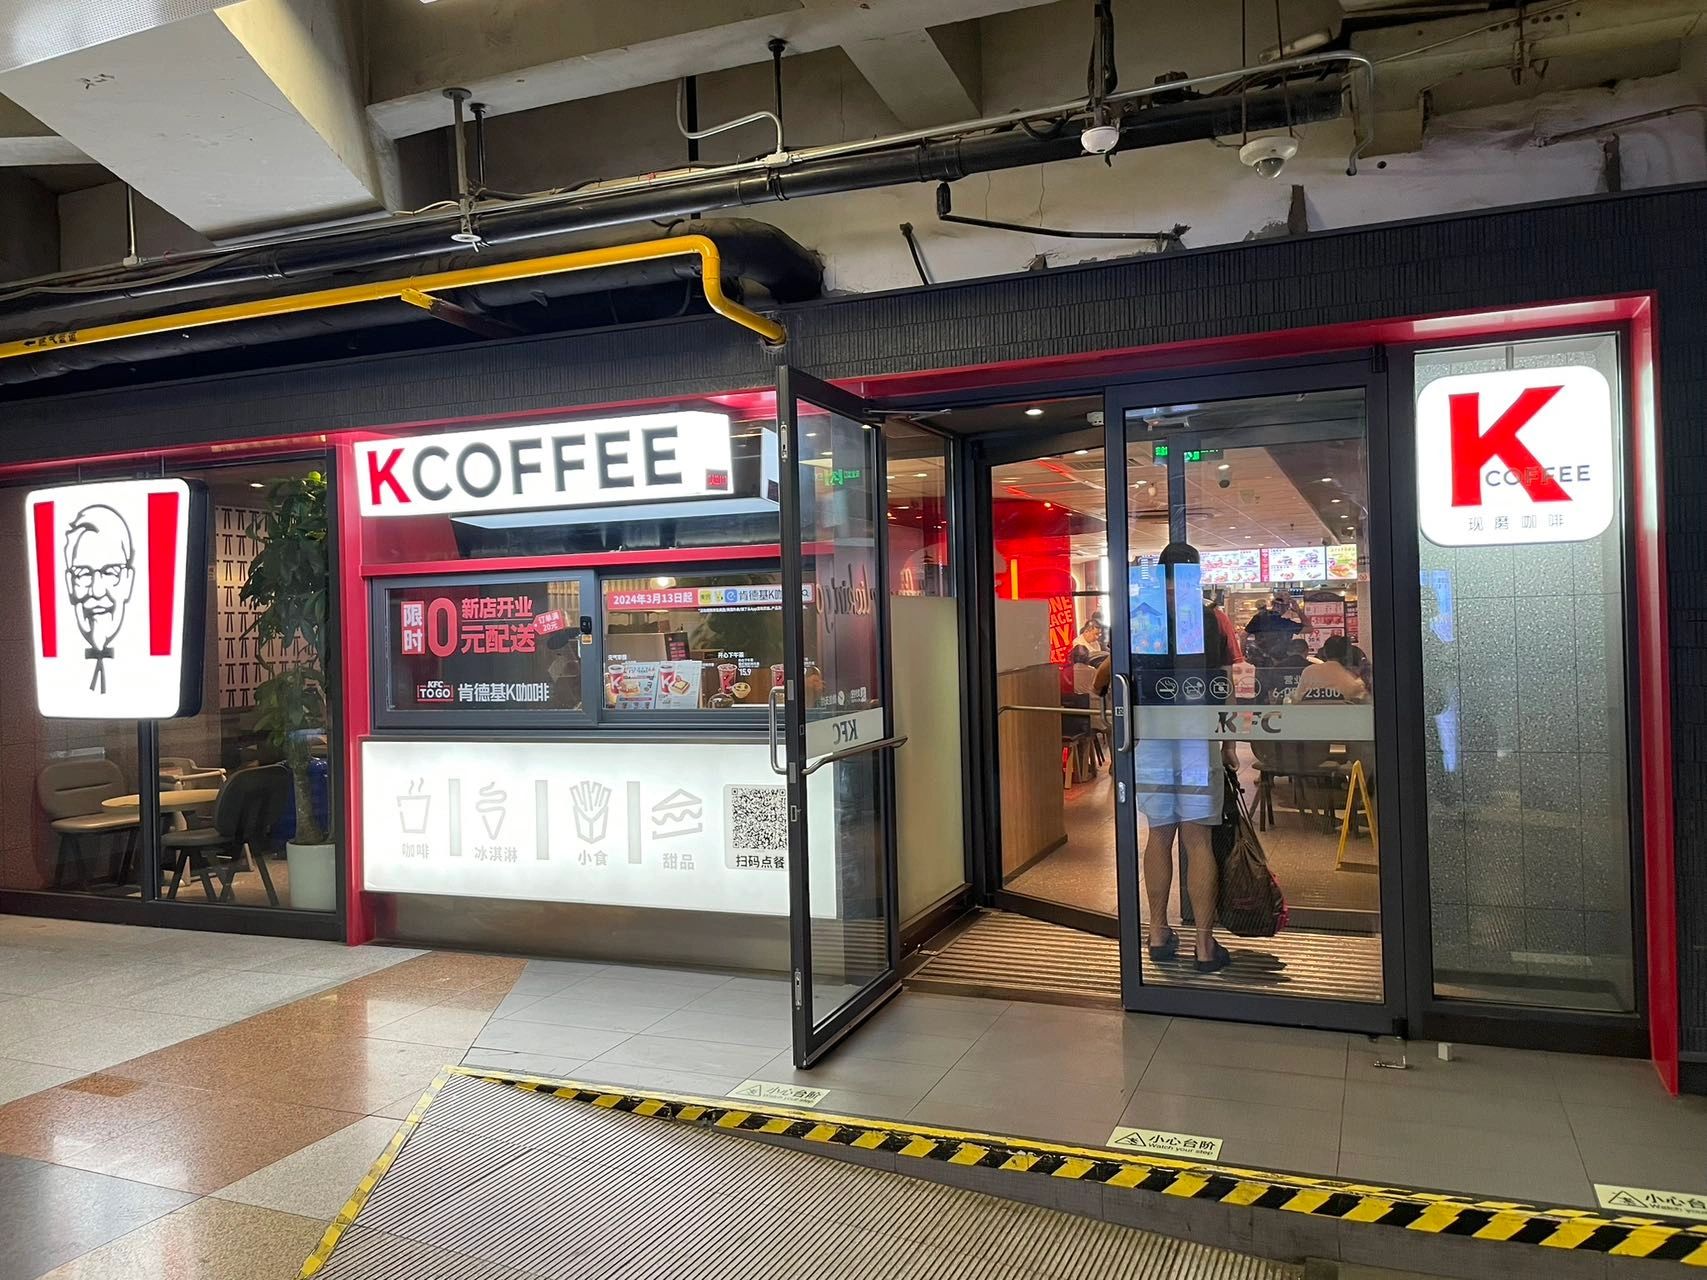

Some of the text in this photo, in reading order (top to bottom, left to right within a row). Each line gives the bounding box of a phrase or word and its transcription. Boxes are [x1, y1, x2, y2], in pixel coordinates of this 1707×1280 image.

[1448, 385, 1574, 507] K
[1485, 465, 1591, 487] COFFEE
[1468, 514, 1564, 532] 现磨咖啡
[613, 592, 693, 605] 2024年3月13日起
[1049, 596, 1072, 613] NE
[461, 596, 534, 619] 新店开业
[427, 597, 458, 657] 0
[543, 621, 559, 632] 20元
[1050, 610, 1073, 628] ACE
[403, 603, 424, 653] 限时
[460, 624, 537, 654] 元配送
[457, 683, 550, 702] 肯德基K咖啡
[1306, 687, 1341, 698] 23:00
[1215, 711, 1282, 733] KFC
[402, 843, 430, 859] 咖啡
[474, 846, 518, 863] 冰淇淋
[577, 849, 608, 866] 小食
[662, 853, 695, 870] 甜品
[735, 855, 785, 869] 扫码点餐
[767, 1087, 821, 1099] 小心台阶
[1149, 1134, 1216, 1151] 小心台阶
[1149, 1143, 1174, 1151] Watch
